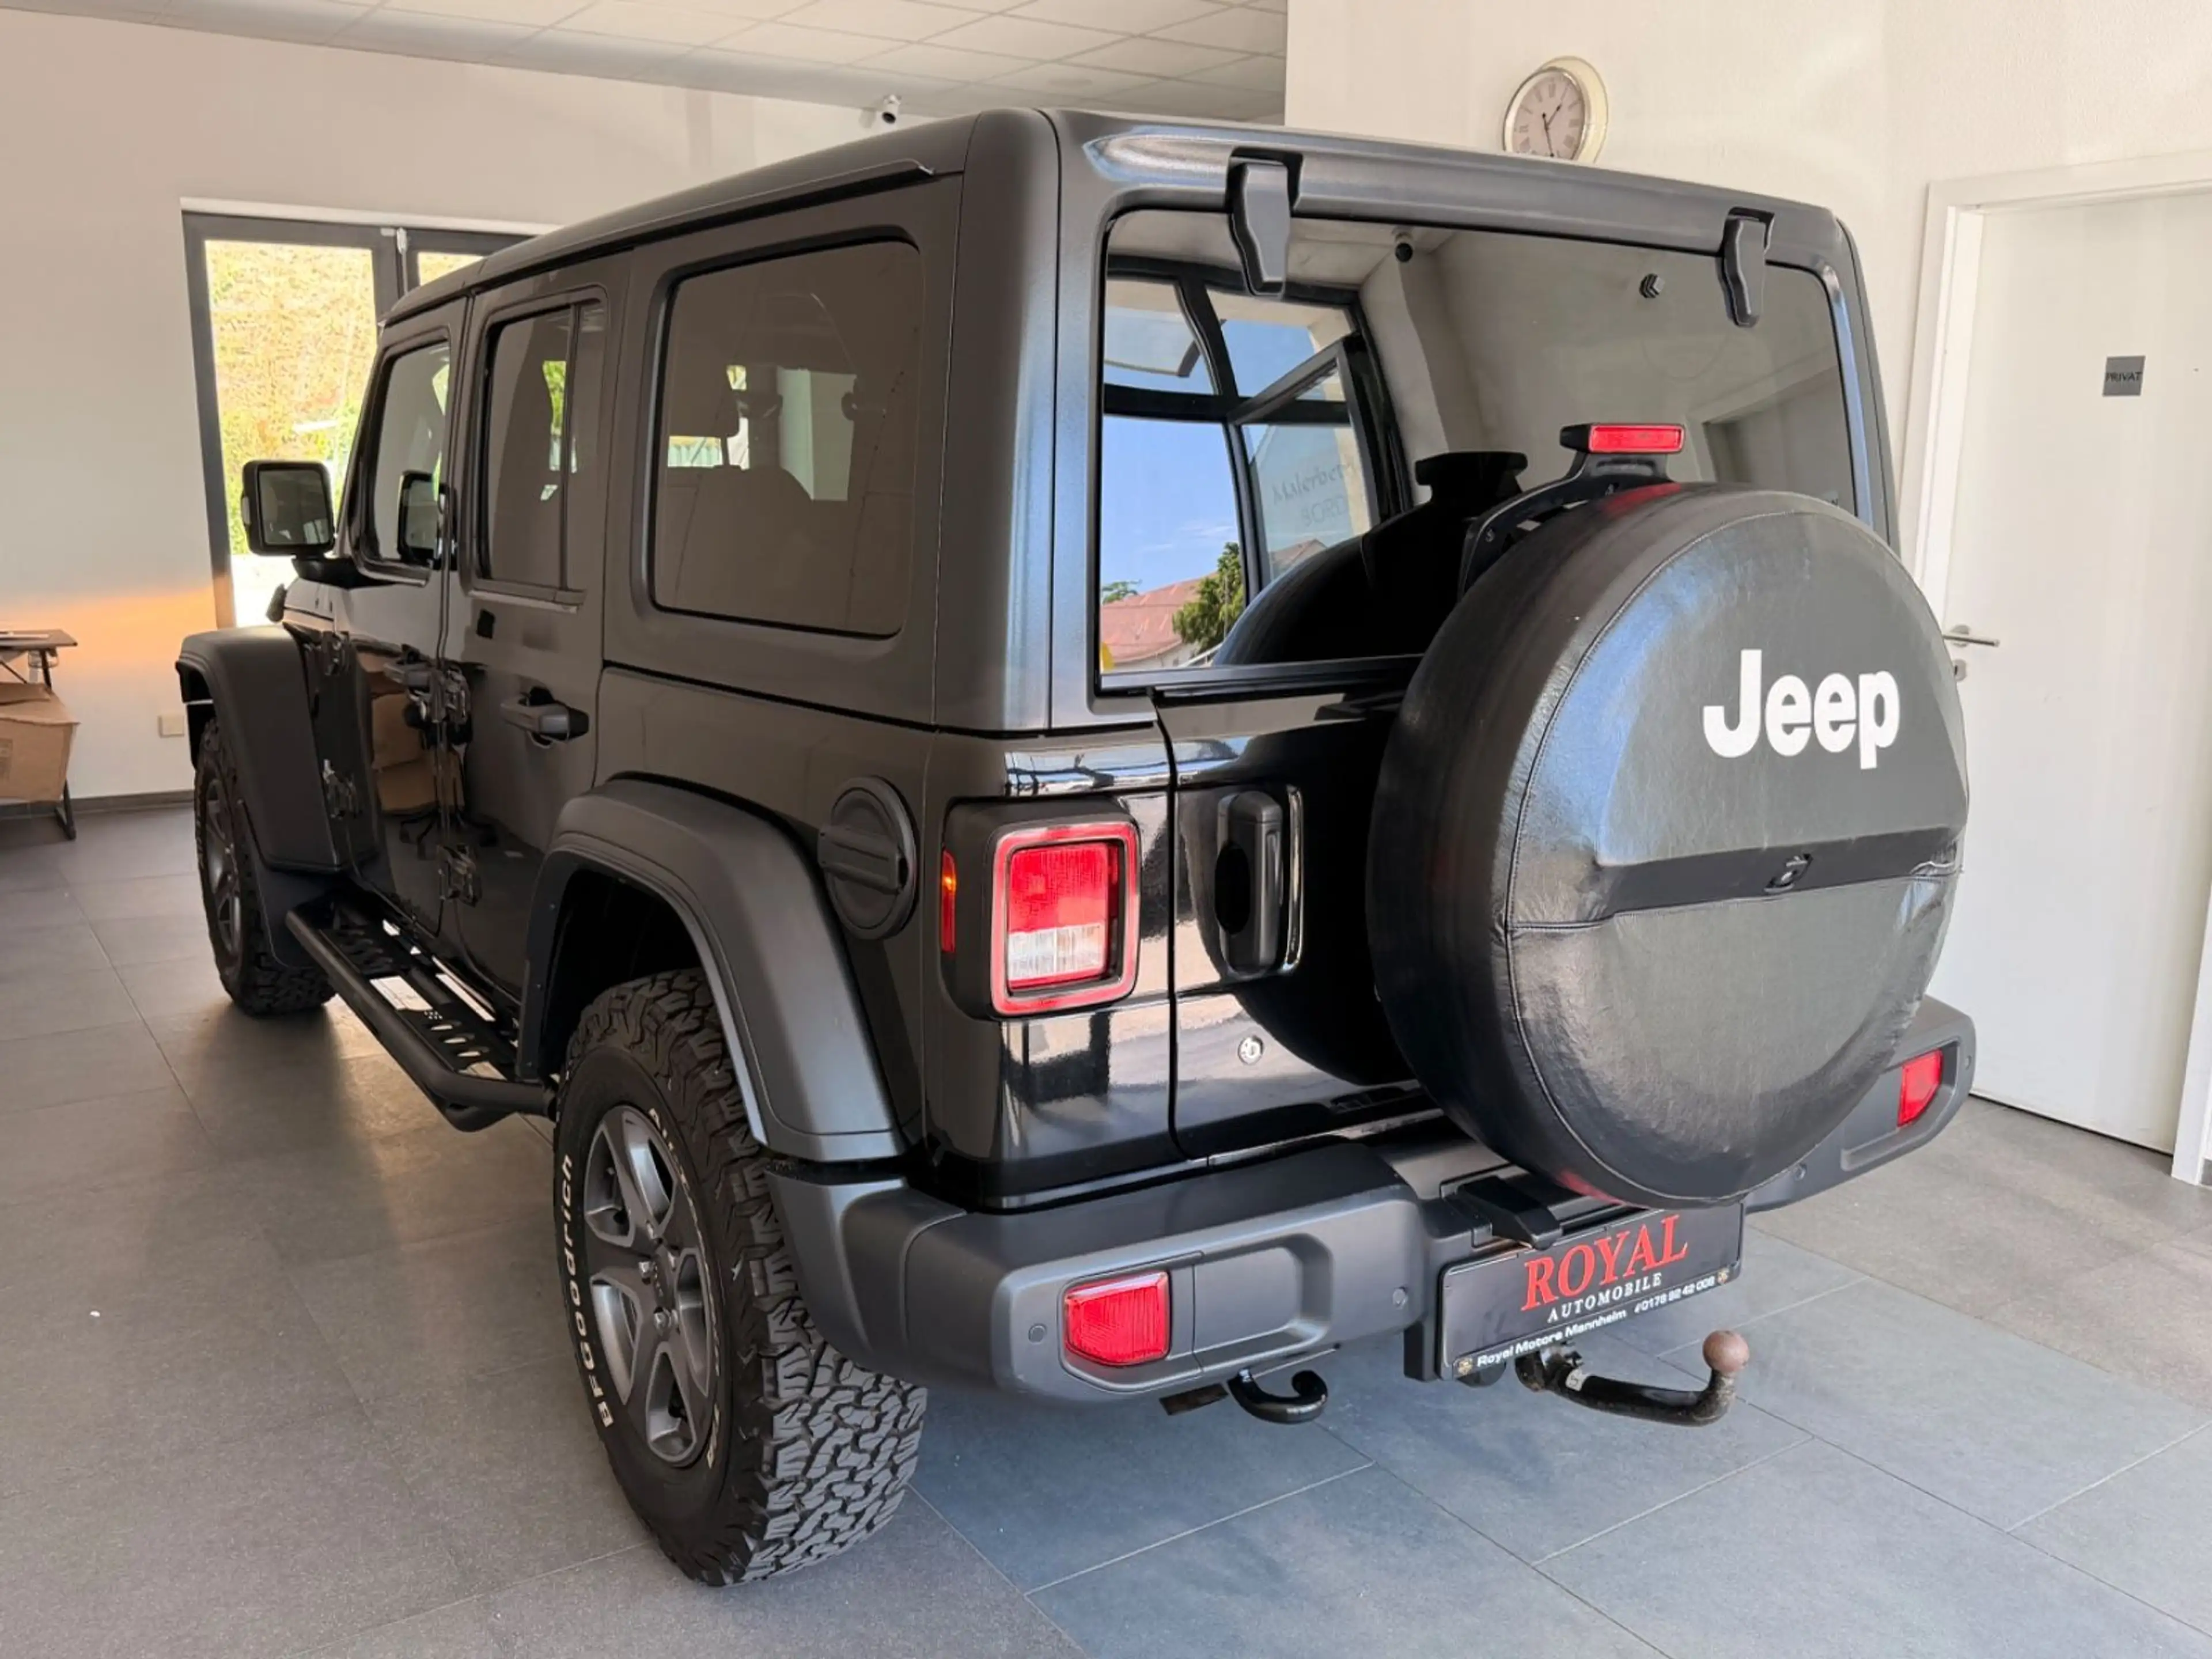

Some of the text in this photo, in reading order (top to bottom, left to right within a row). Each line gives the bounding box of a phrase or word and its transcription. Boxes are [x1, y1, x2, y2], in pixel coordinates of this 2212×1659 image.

[2105, 371, 2143, 382] PRIVAT
[1703, 649, 1900, 770] Jeep
[1521, 1214, 1688, 1311] ROYAL
[1547, 1272, 1662, 1323] AUTOMOBILE
[1477, 1346, 1514, 1367] Royal
[1515, 1331, 1563, 1354] Motors
[1565, 1309, 1627, 1338] Mannheim
